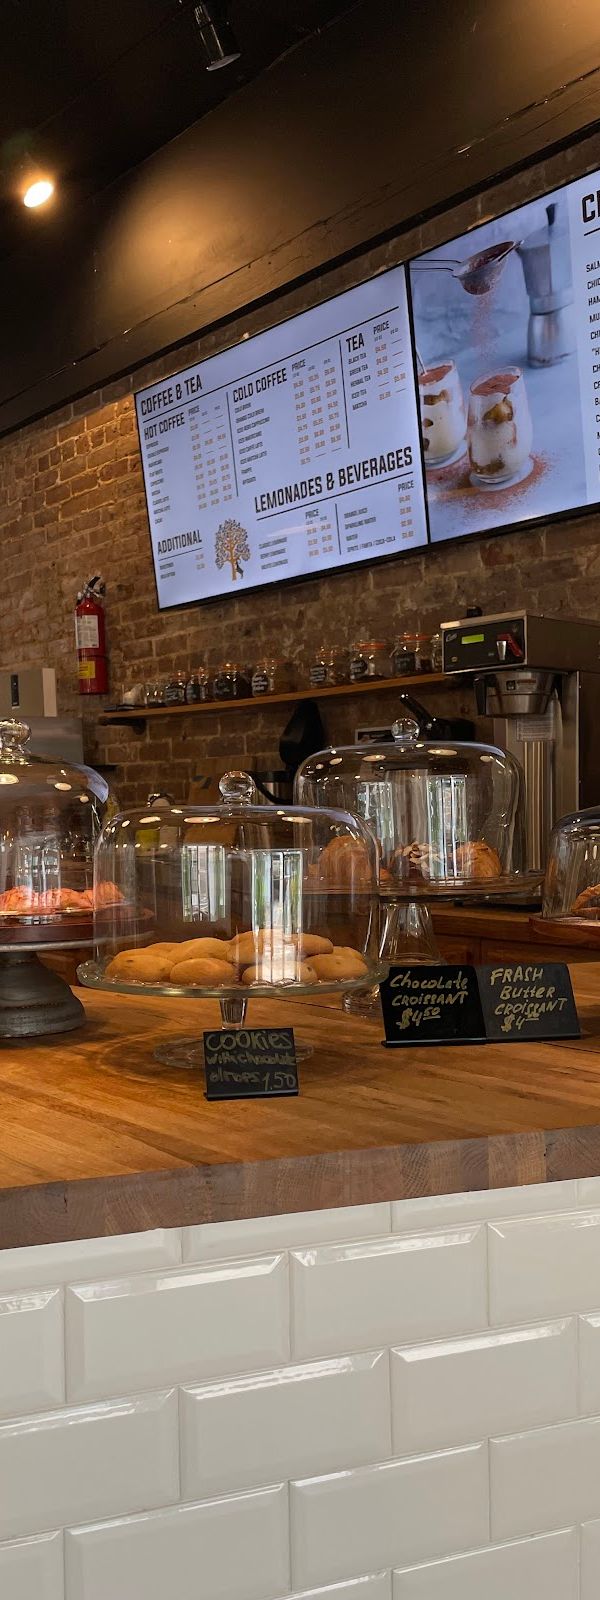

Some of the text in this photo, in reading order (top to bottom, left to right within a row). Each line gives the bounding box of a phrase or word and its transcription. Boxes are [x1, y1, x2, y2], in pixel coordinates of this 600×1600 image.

[582, 190, 600, 223] C
[373, 320, 390, 335] PRICE
[345, 332, 365, 353] TEA
[292, 359, 306, 372] PRICE
[140, 374, 203, 416] COFFEE & TEA
[233, 379, 254, 403] COLD
[256, 368, 287, 393] COFFEE
[188, 405, 200, 416] PRICE
[144, 412, 185, 440] HOT COFFEE
[254, 446, 413, 513] LEMONADES & BEVERAGES
[397, 480, 414, 492] PRICE
[305, 508, 319, 519] PRICE
[157, 530, 203, 555] ADDITIONAL
